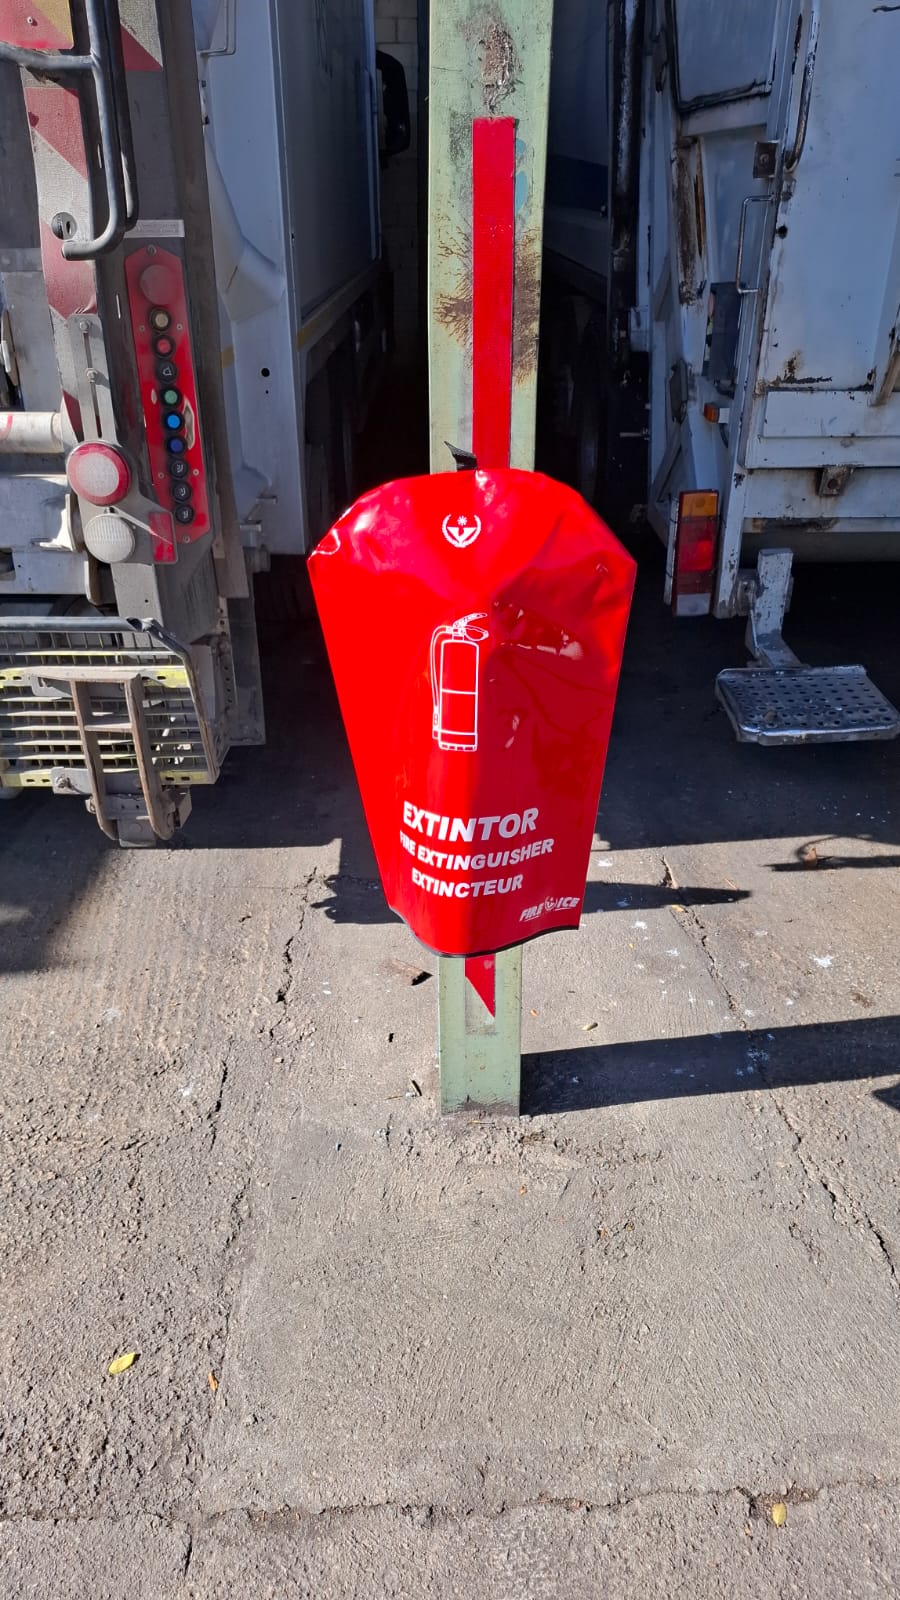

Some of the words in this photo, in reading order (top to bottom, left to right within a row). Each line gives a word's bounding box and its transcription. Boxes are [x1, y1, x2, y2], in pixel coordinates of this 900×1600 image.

[403, 800, 539, 842] EXTINTOR
[400, 830, 416, 856] FIRE
[417, 838, 555, 870] EXTINGUISHER
[411, 867, 524, 898] EXTINCTEUR
[519, 902, 545, 922] FIRE
[556, 896, 580, 911] ICE
